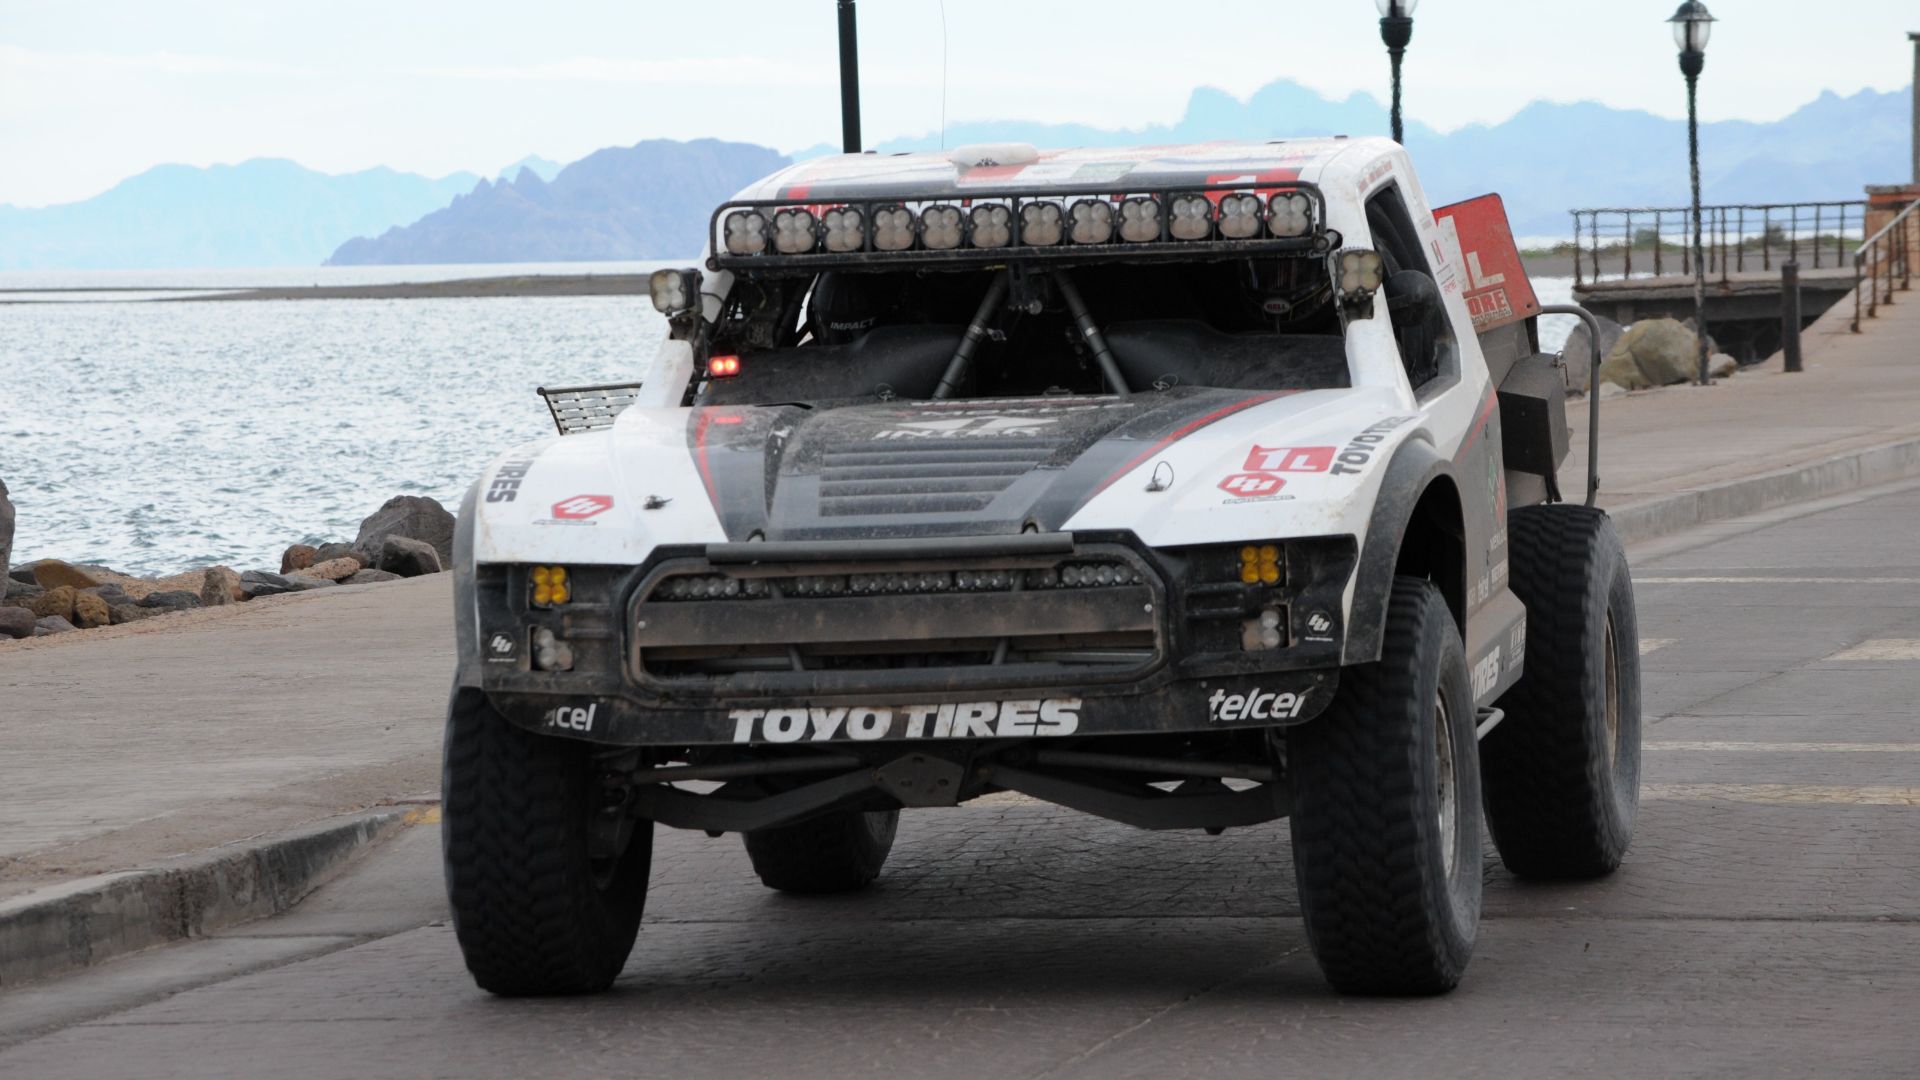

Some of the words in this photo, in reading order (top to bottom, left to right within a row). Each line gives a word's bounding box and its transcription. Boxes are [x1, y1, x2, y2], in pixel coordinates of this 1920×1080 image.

[831, 316, 877, 331] IMPACT
[1329, 434, 1385, 476] TOYO
[486, 459, 535, 503] TIRES
[728, 707, 893, 743] TOYO
[901, 698, 1082, 738] TIRES
